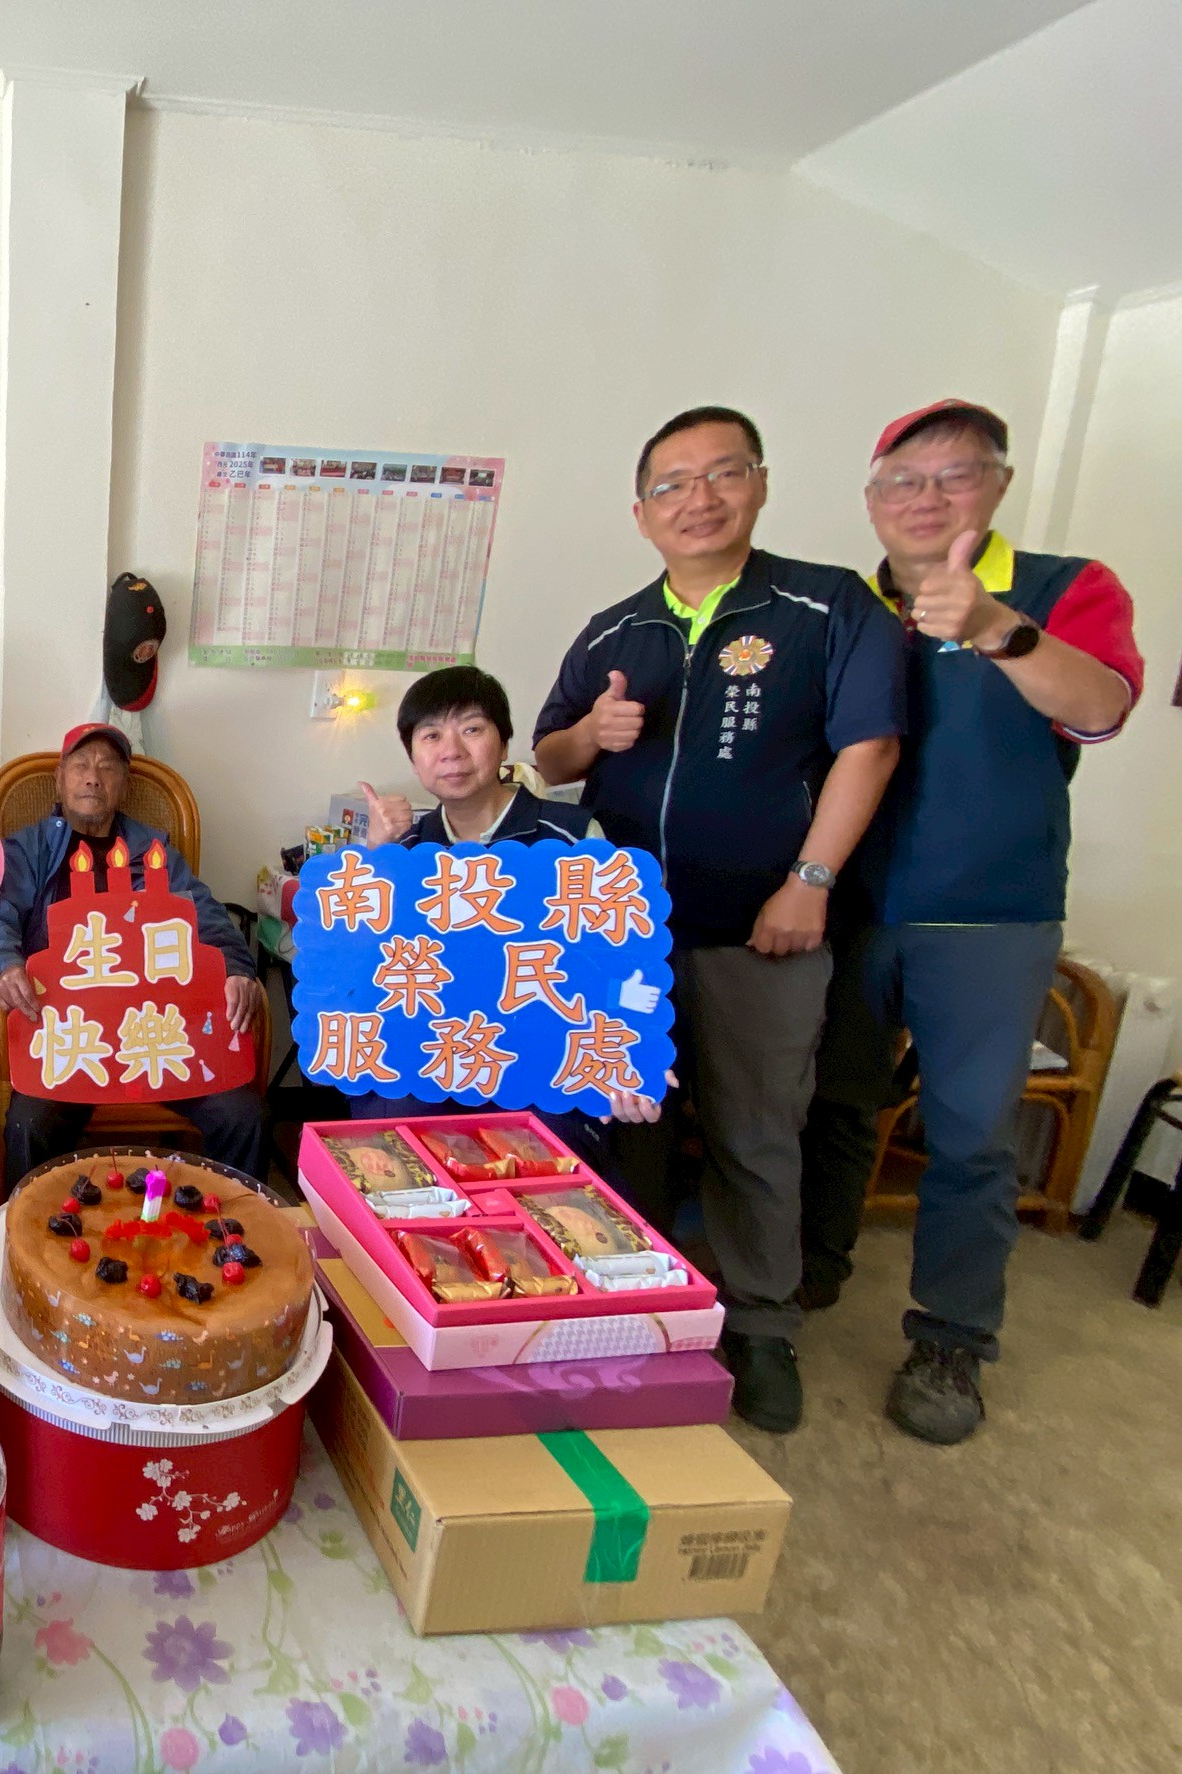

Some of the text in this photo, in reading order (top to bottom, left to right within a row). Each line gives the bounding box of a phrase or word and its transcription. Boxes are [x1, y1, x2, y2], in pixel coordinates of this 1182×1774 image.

[717, 685, 740, 759] 榮民服務處
[742, 682, 761, 731] 南投縣
[316, 851, 654, 945] 南投縣
[59, 911, 193, 990] 生日
[373, 935, 586, 1024] 榮民
[29, 1001, 196, 1089] 快樂
[307, 1010, 656, 1098] 服務處
